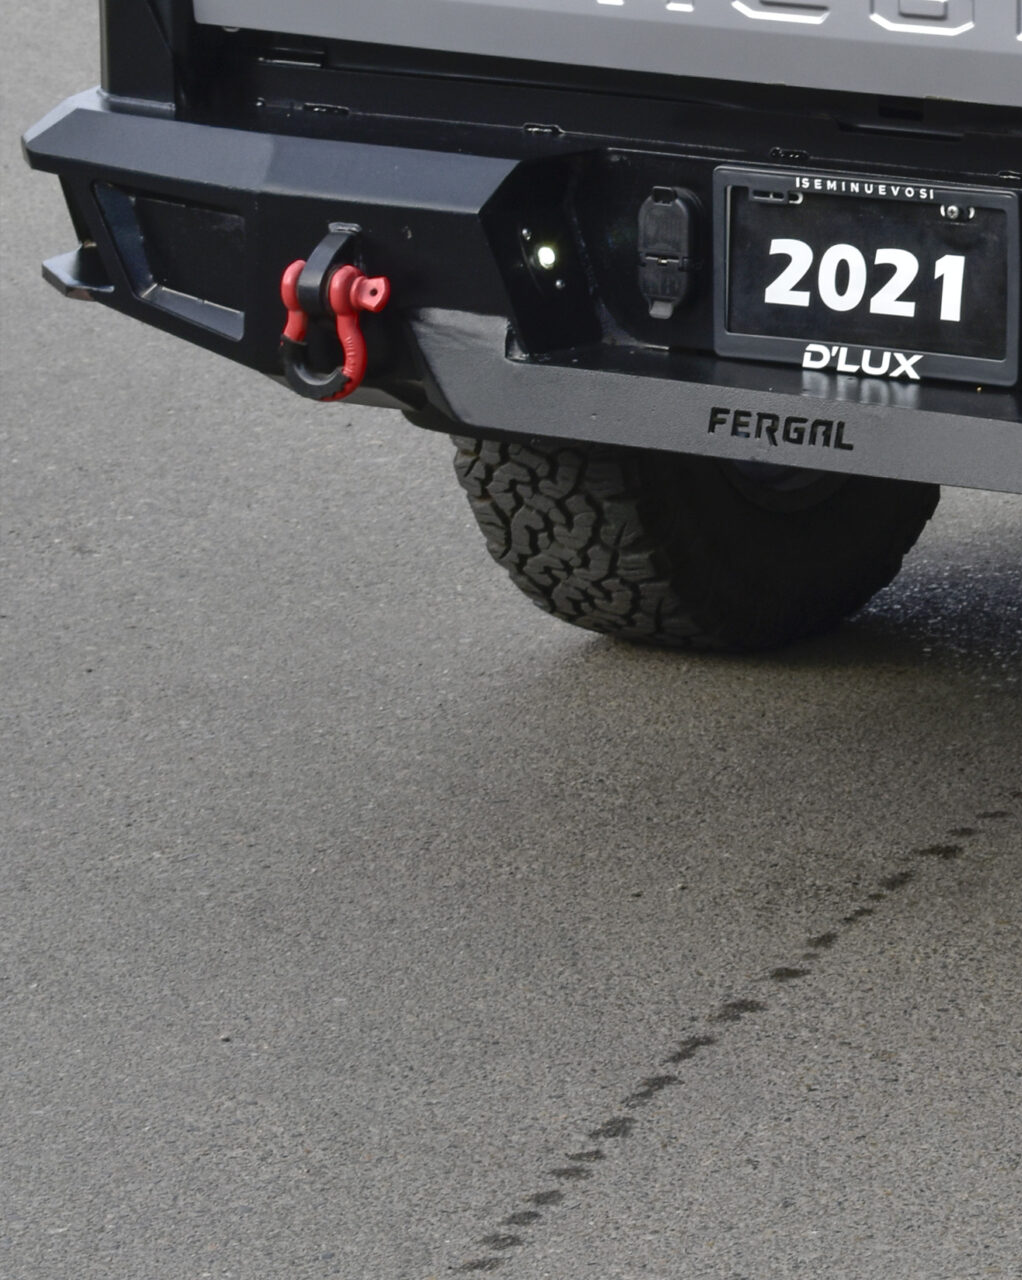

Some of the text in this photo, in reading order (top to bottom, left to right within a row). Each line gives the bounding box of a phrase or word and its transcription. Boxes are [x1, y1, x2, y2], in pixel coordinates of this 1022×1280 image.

[801, 176, 929, 200] SEMINUEVOS
[764, 238, 966, 322] 2021
[802, 343, 924, 380] D'LUX
[707, 406, 854, 451] FERGAL
